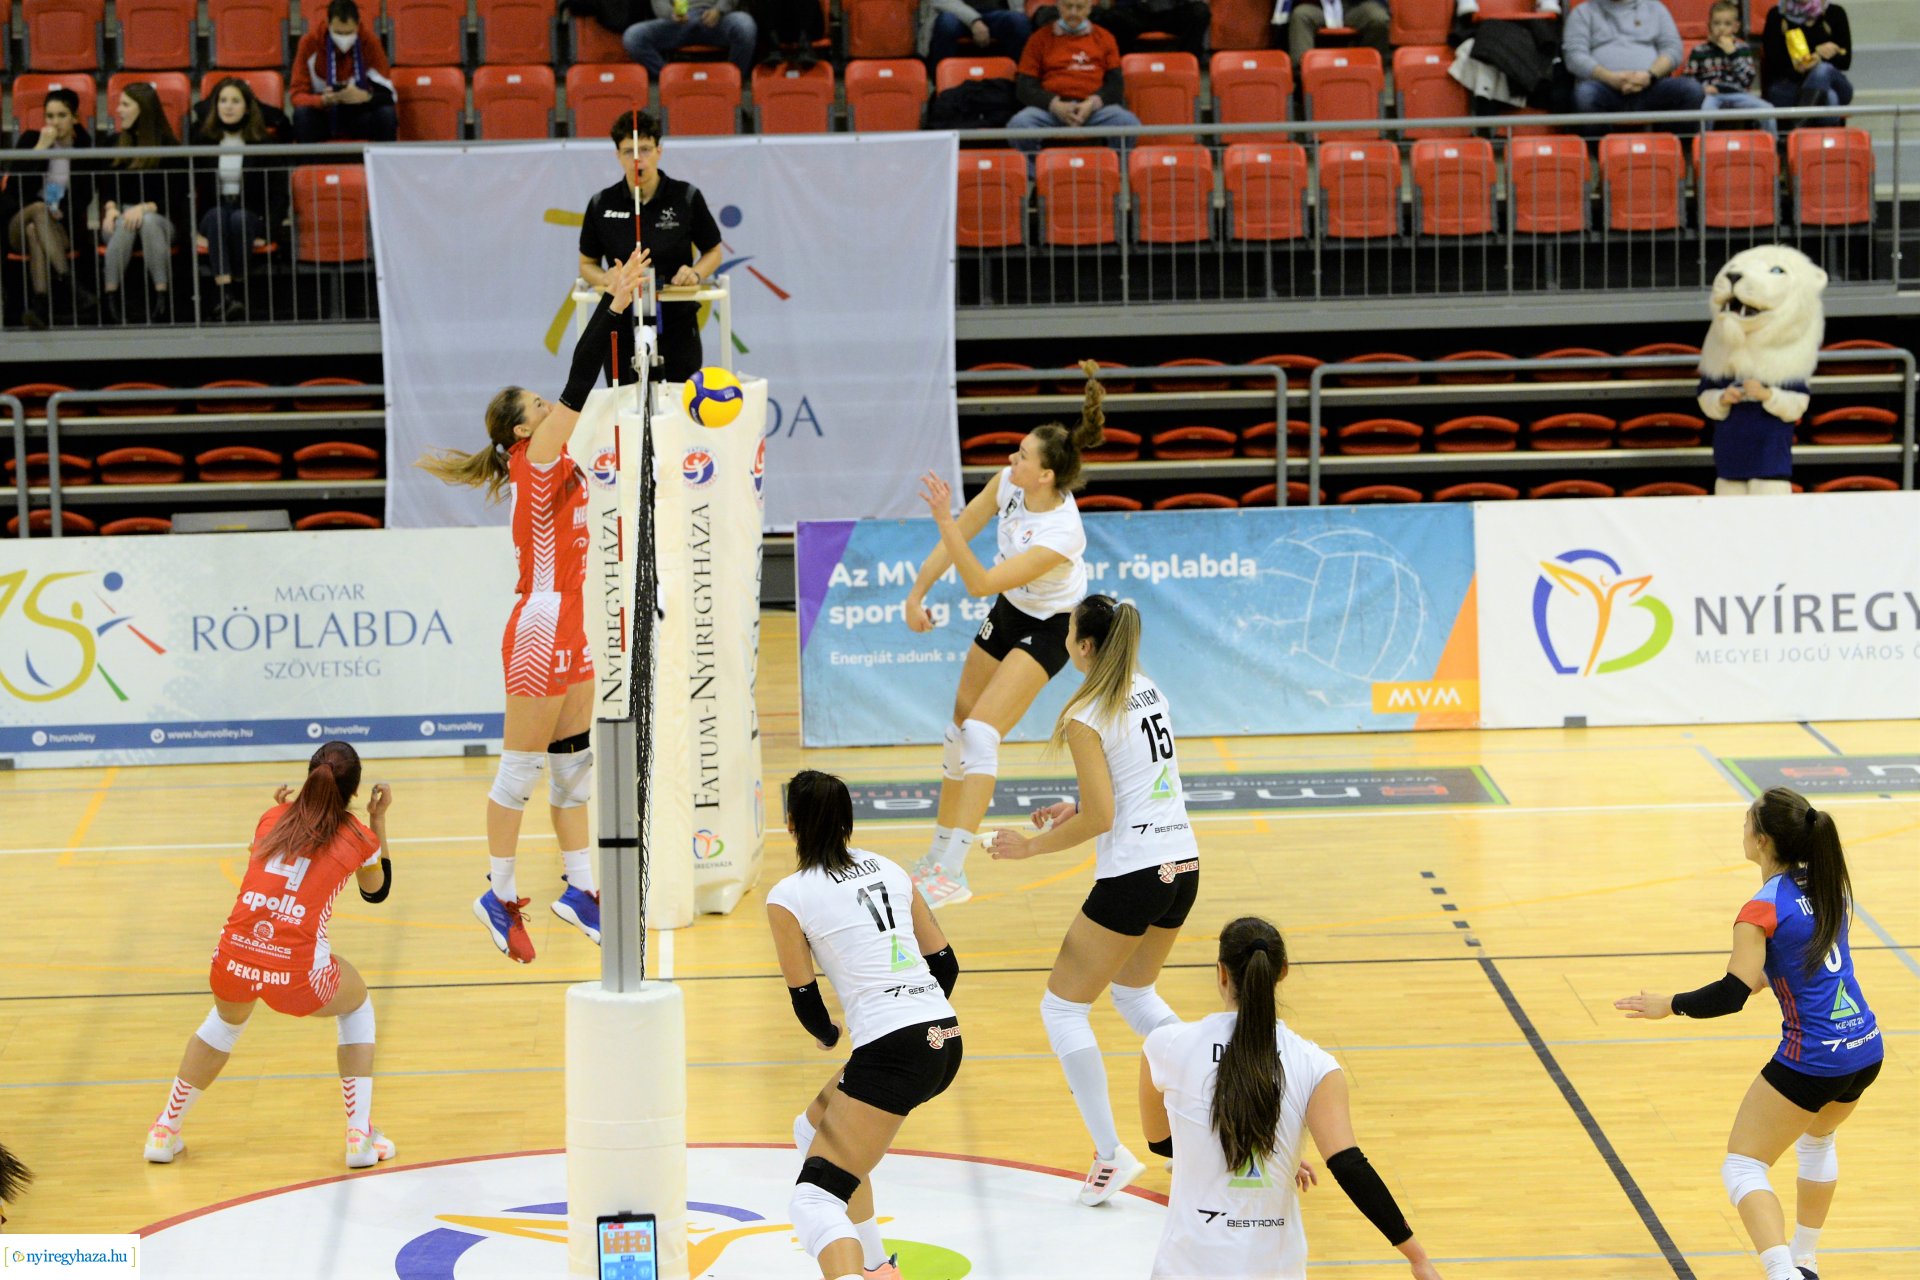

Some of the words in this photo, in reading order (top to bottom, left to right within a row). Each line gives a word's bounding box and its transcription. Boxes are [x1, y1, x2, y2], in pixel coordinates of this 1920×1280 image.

[603, 209, 631, 219] Zeus
[828, 562, 869, 588] Az
[1119, 551, 1257, 584] röplabda
[275, 583, 365, 603] MAGYAR
[828, 596, 950, 630] sportg
[191, 606, 454, 652] RÖPLABDA
[830, 649, 893, 667] Energiát
[897, 649, 943, 664] adunk
[946, 651, 956, 662] a
[1695, 648, 1770, 665] MEGYEI
[1778, 643, 1831, 662] JOGÚ
[1838, 642, 1905, 661] VÁROS
[263, 657, 382, 680] SZÖVETSÉG
[1388, 686, 1462, 709] MVM
[48, 730, 96, 745] hunvolley
[166, 727, 254, 741] www.hunvolley.hu
[324, 723, 371, 738] hunvolley
[437, 719, 485, 734] hunvolley
[1140, 712, 1174, 763] 15
[264, 850, 311, 893] 4
[242, 891, 306, 918] apollo
[855, 881, 896, 933] 17
[269, 911, 303, 926] TYRES
[231, 933, 292, 955] SZABADICS
[226, 959, 261, 981] PEKA
[262, 970, 291, 985] BAU
[1226, 1218, 1285, 1228] BESTRONG
